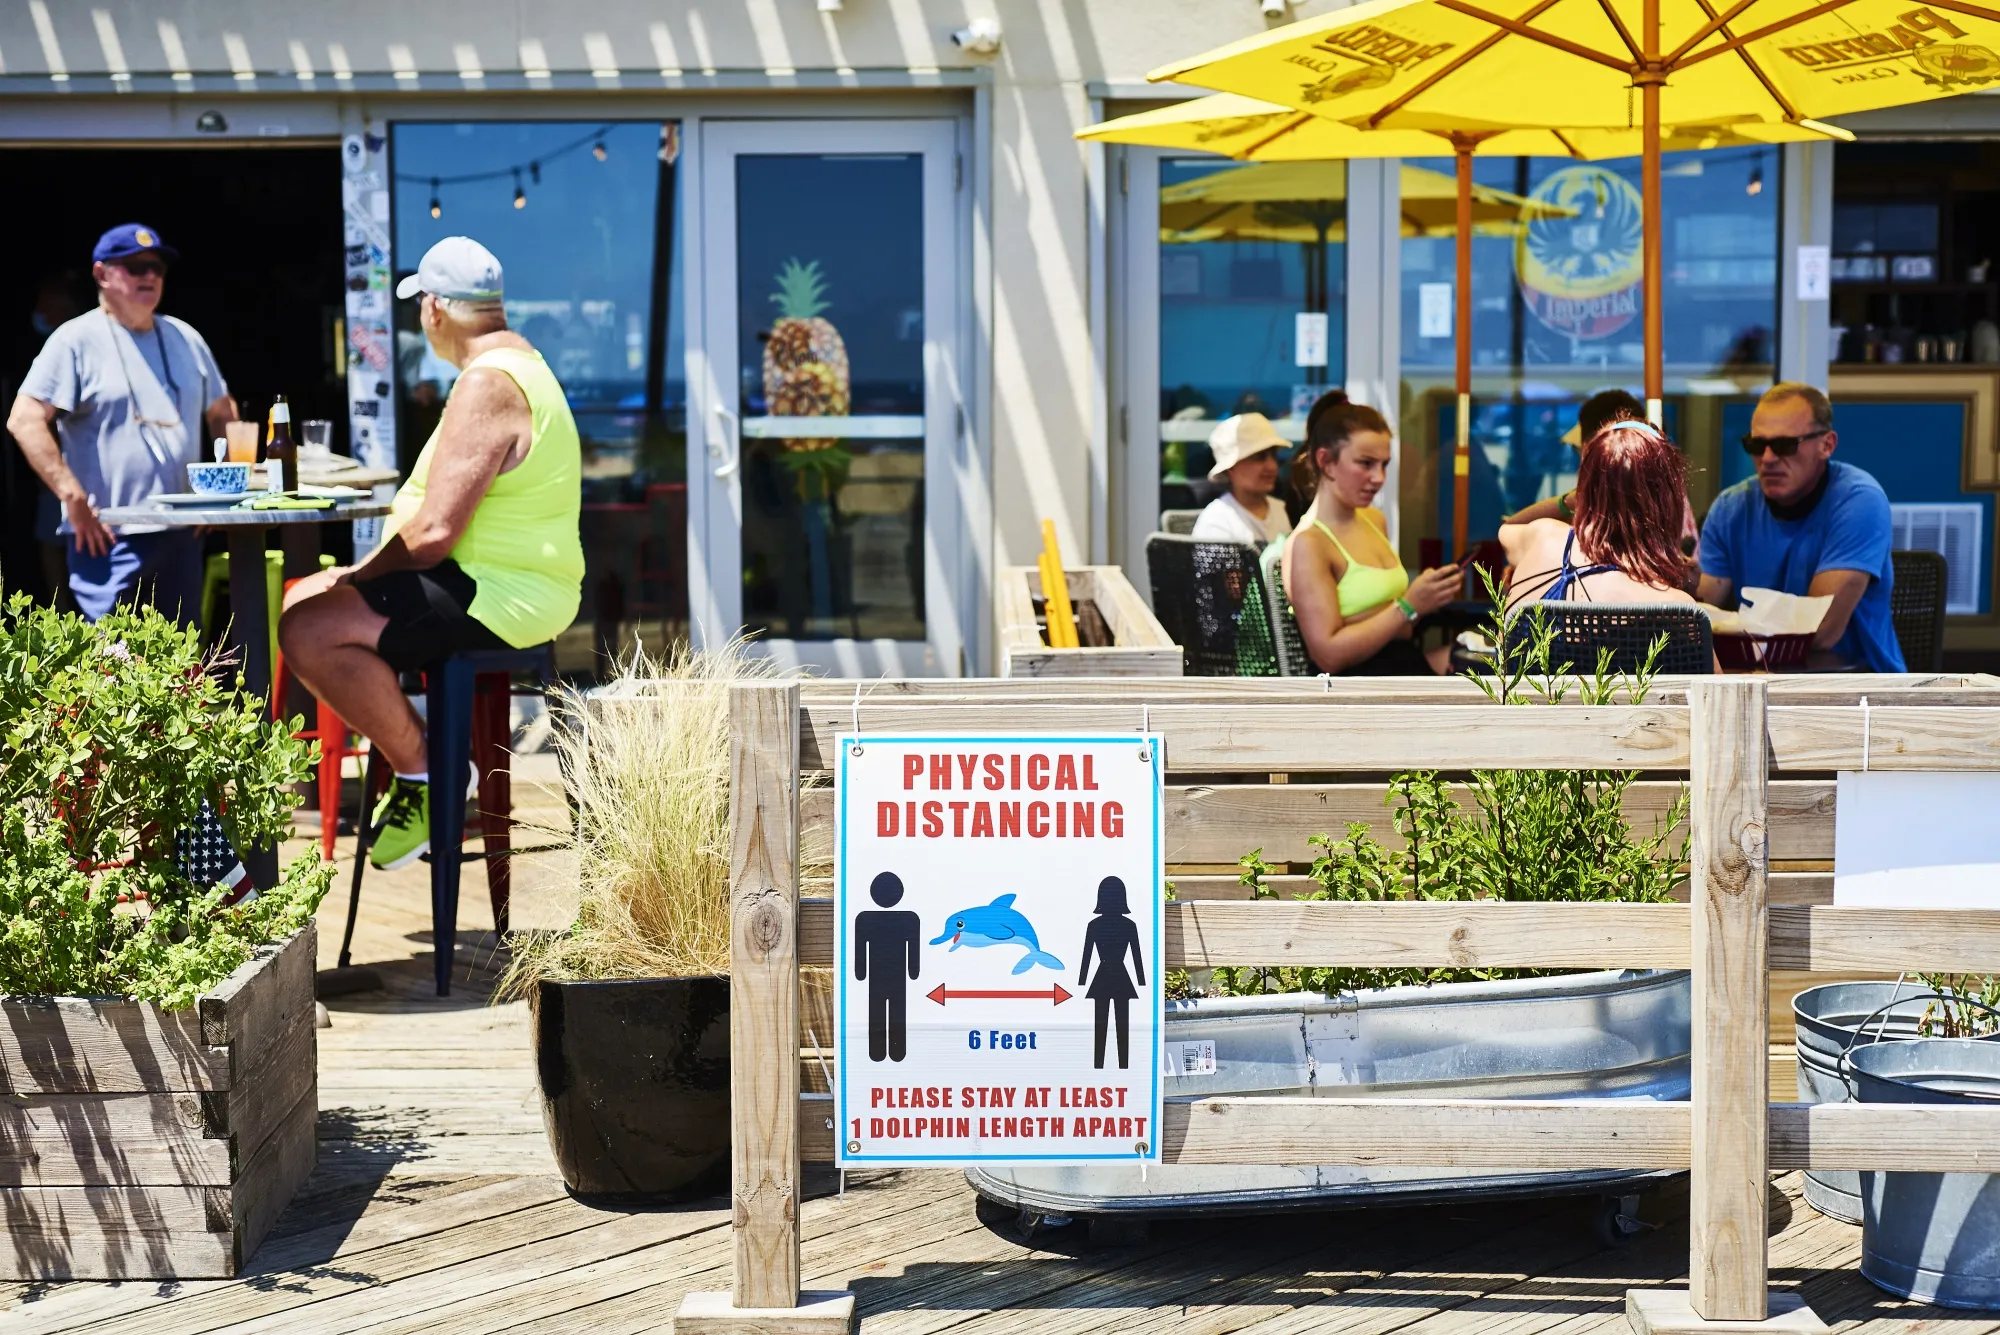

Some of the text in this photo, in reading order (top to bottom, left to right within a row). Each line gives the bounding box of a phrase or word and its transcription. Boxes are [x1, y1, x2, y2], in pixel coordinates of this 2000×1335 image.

[1545, 284, 1637, 329] Imperial
[903, 753, 1099, 791] PHYSICAL
[877, 800, 1124, 839] DISTANCING
[968, 1029, 1037, 1050] 6 Feet
[871, 1087, 1127, 1108] PLEASE STAY AT LEAST
[850, 1117, 1146, 1139] 1 DOLPHIN LENGTH APART
